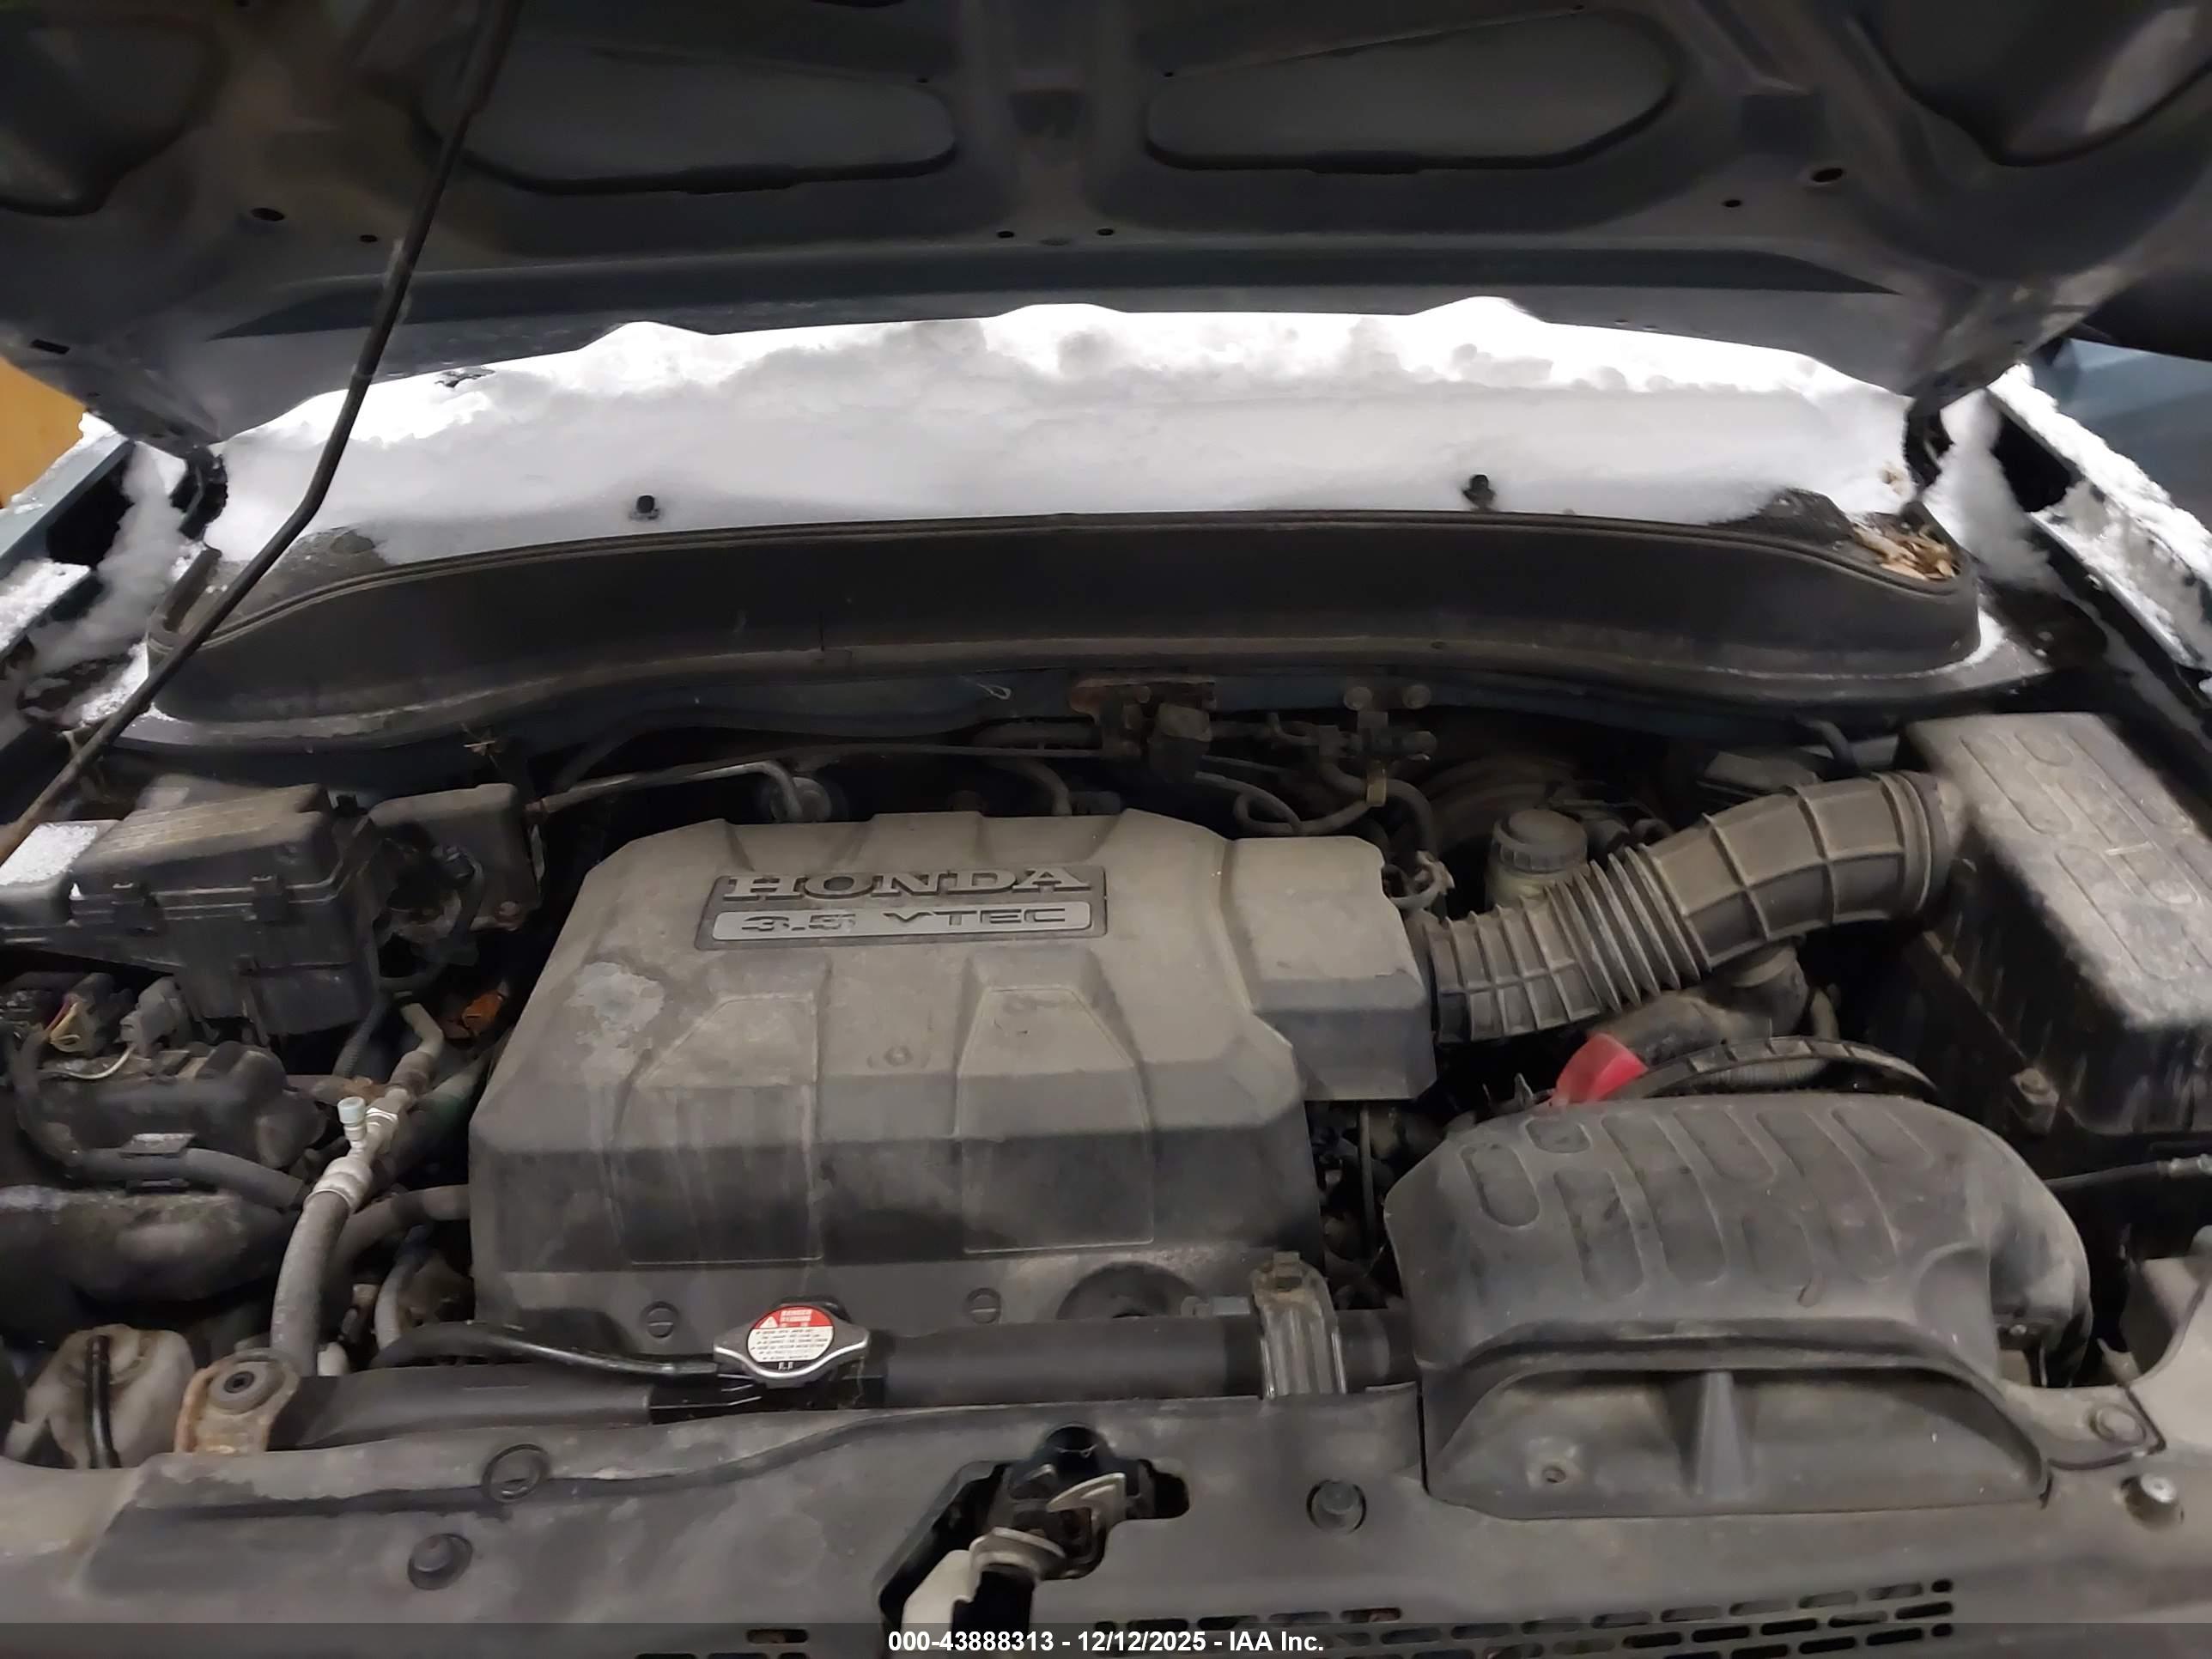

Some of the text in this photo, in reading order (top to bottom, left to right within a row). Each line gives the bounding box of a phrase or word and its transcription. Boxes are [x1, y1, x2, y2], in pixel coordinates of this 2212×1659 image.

[722, 867, 1091, 901] HONDA
[741, 908, 1066, 932] 3.5 VTEC
